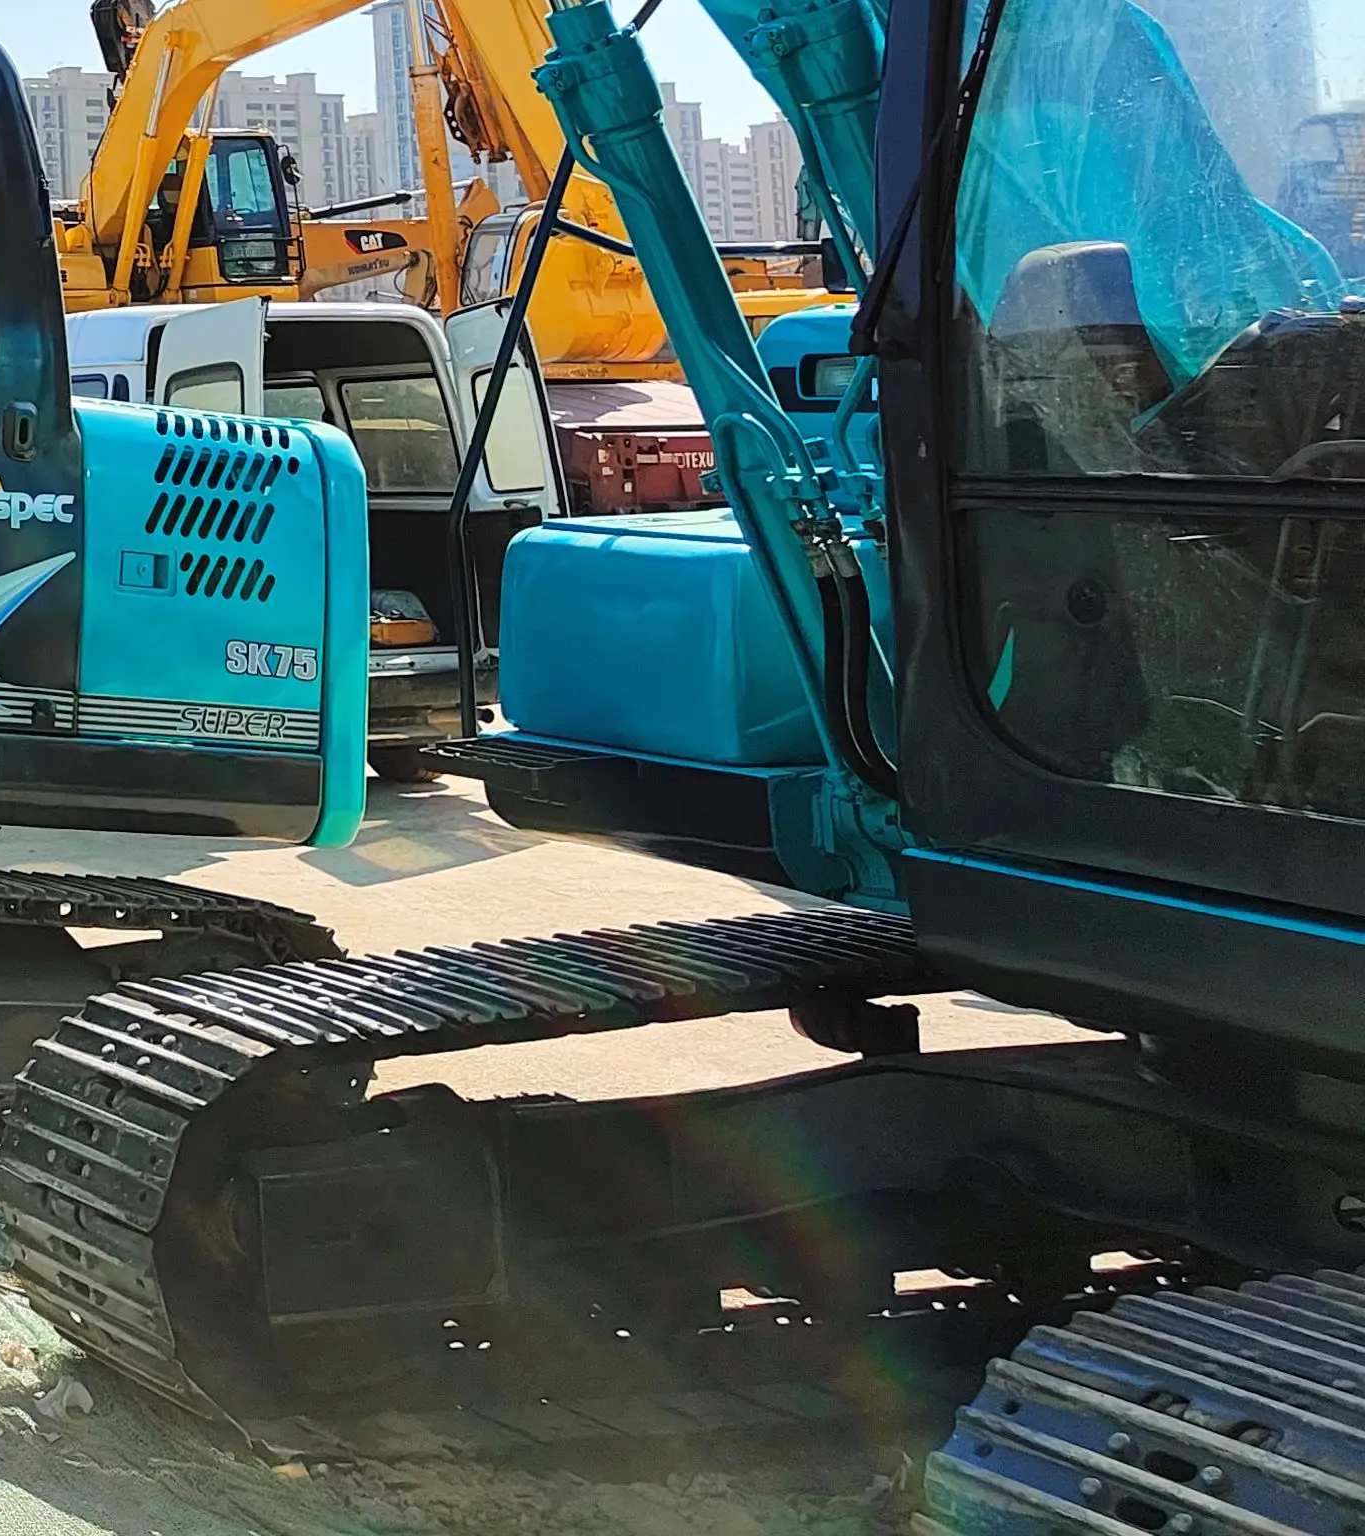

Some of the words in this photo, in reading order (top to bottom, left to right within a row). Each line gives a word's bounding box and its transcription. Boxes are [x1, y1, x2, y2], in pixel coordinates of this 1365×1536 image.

[360, 232, 384, 252] CAT
[225, 639, 318, 681] SK75
[177, 706, 286, 738] SUPER
